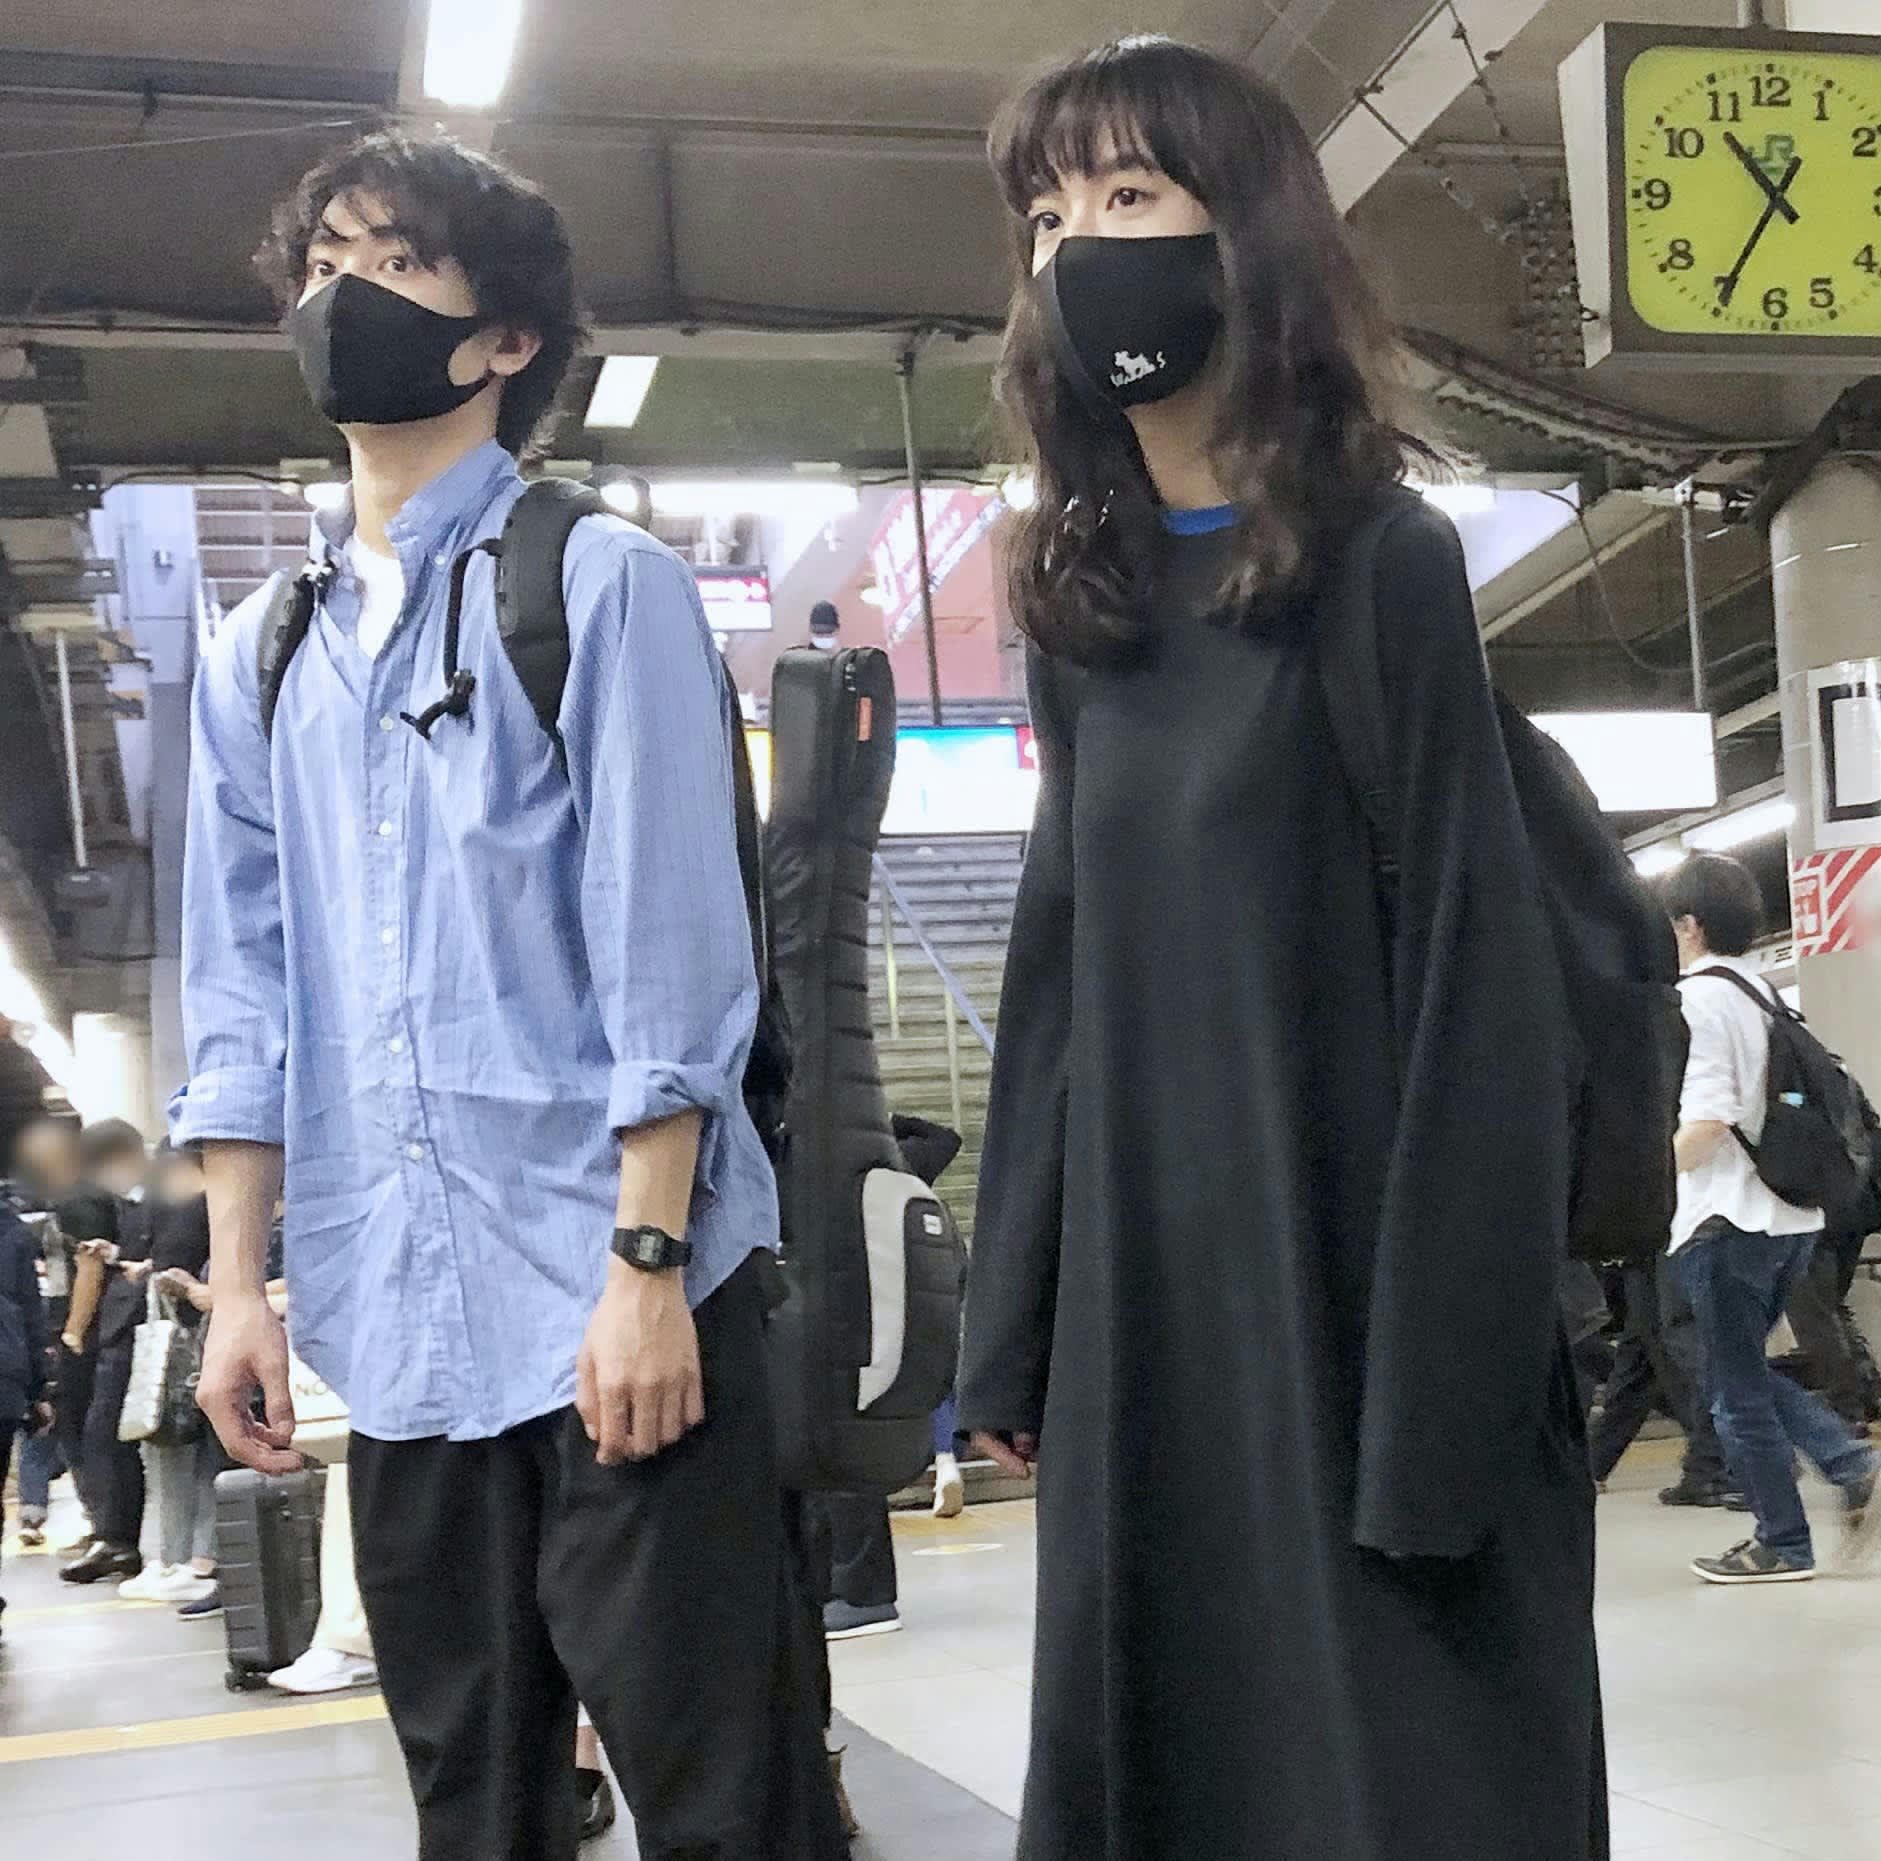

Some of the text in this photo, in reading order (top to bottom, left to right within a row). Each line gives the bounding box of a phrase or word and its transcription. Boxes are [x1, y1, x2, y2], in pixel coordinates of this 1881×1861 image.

[1707, 91, 1742, 122] 11
[1749, 76, 1792, 108] 12
[1813, 91, 1830, 121] 1
[1664, 128, 1704, 158] 10
[1852, 127, 1878, 157] 2
[1644, 178, 1672, 210] 9
[1667, 239, 1695, 270] 8
[1853, 244, 1878, 273] 4
[1762, 288, 1788, 319] 6
[1809, 277, 1835, 309] 5
